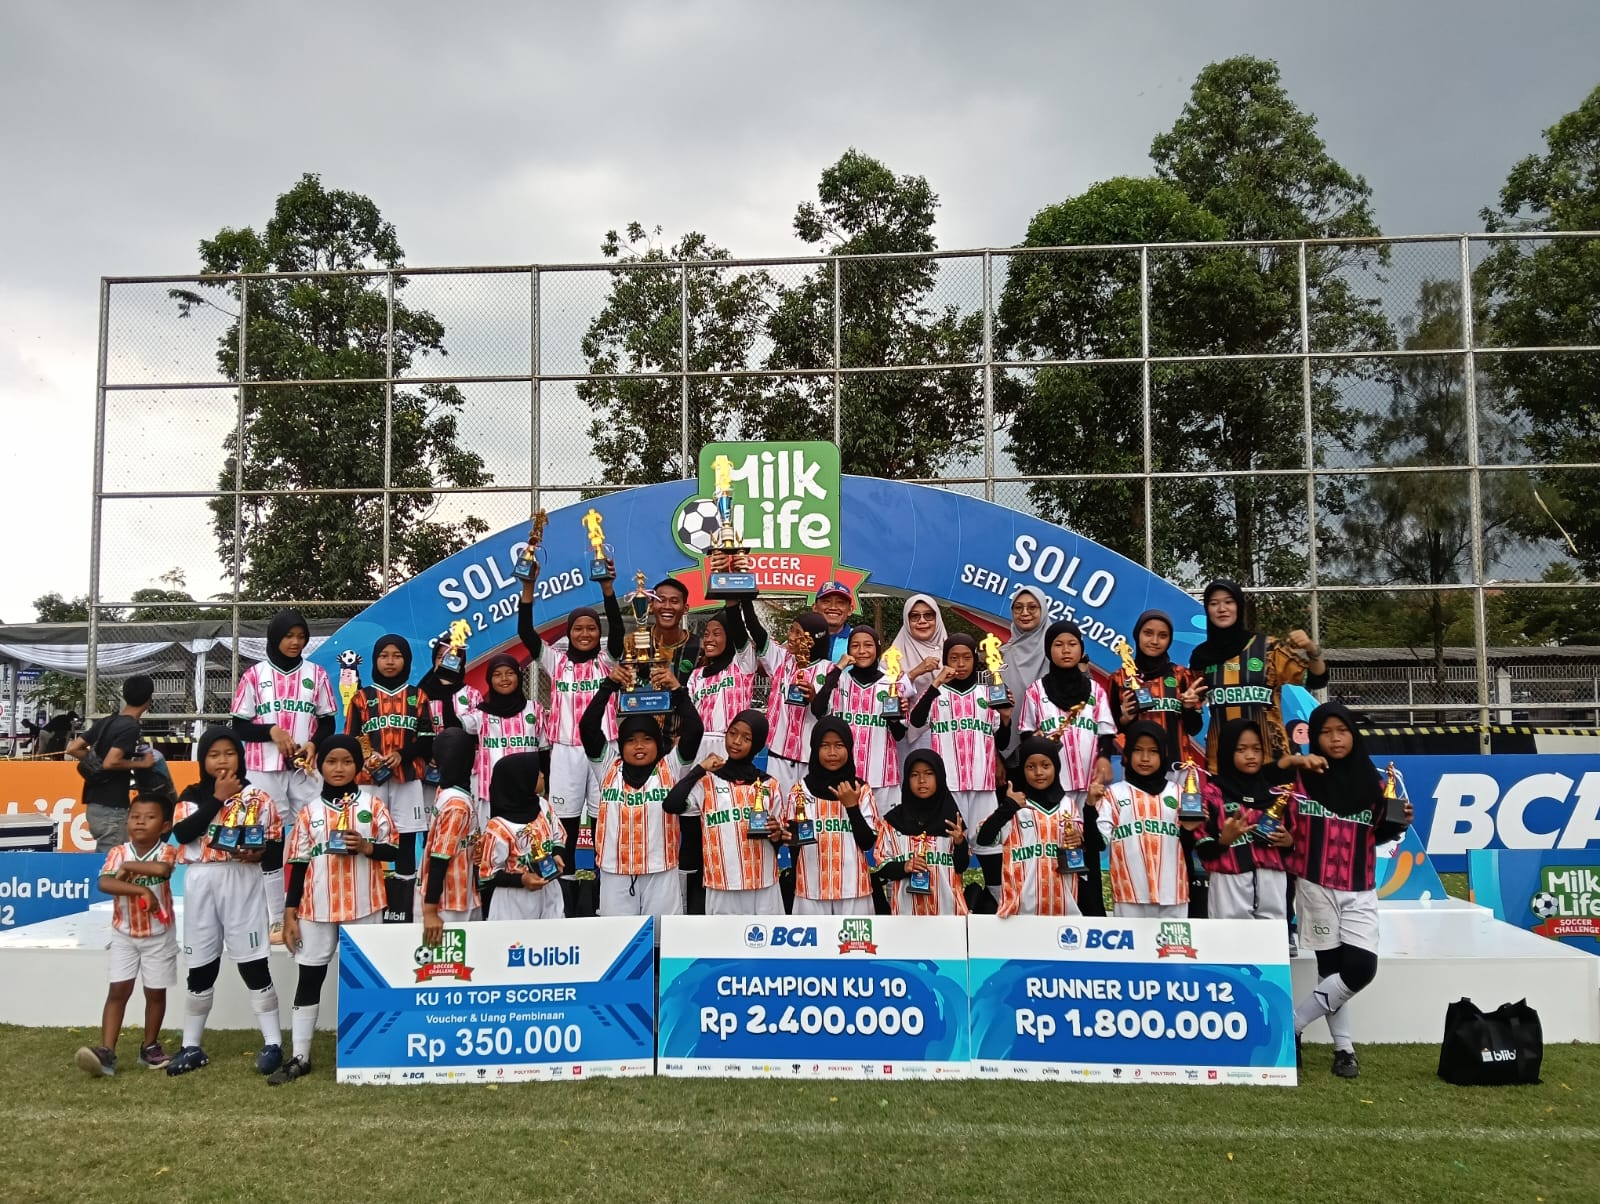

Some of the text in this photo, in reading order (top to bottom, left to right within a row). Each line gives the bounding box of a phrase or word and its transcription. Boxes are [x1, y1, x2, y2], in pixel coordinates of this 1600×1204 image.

[733, 500, 832, 550] Life
[749, 556, 800, 570] OCCER
[1008, 534, 1116, 608] SOLO
[756, 572, 816, 587] LLENGE
[960, 564, 1008, 595] SERI
[473, 568, 584, 632] 2 202-2026
[1215, 688, 1224, 704] 9
[380, 716, 387, 726] 9
[950, 720, 958, 730] 9
[501, 738, 507, 747] 9
[706, 810, 730, 826] MIN
[732, 808, 741, 821] 9
[815, 820, 823, 832] 9
[1134, 821, 1143, 834] 9
[1012, 845, 1034, 862] MIN
[1034, 843, 1043, 857] 9
[37, 878, 90, 899] Putri
[1559, 893, 1600, 916] Life
[442, 931, 462, 947] ilk
[770, 927, 818, 947] BCA
[850, 930, 870, 941] Life
[1085, 929, 1134, 950] BCA
[1169, 934, 1190, 945] Life
[433, 947, 463, 962] Life
[528, 946, 580, 966] blibli
[717, 976, 906, 998] CHAMPION KU 10
[1026, 977, 1234, 1003] RUNNER UP KU 12
[416, 988, 576, 1006] KU 10 TOP SCORER
[426, 1011, 565, 1024] Voucher & Uang Pembinaan
[701, 1005, 924, 1040] Rp 2.400.000
[1016, 1009, 1248, 1043] Rp 1.800.000
[407, 1025, 582, 1062] Rp 350.000
